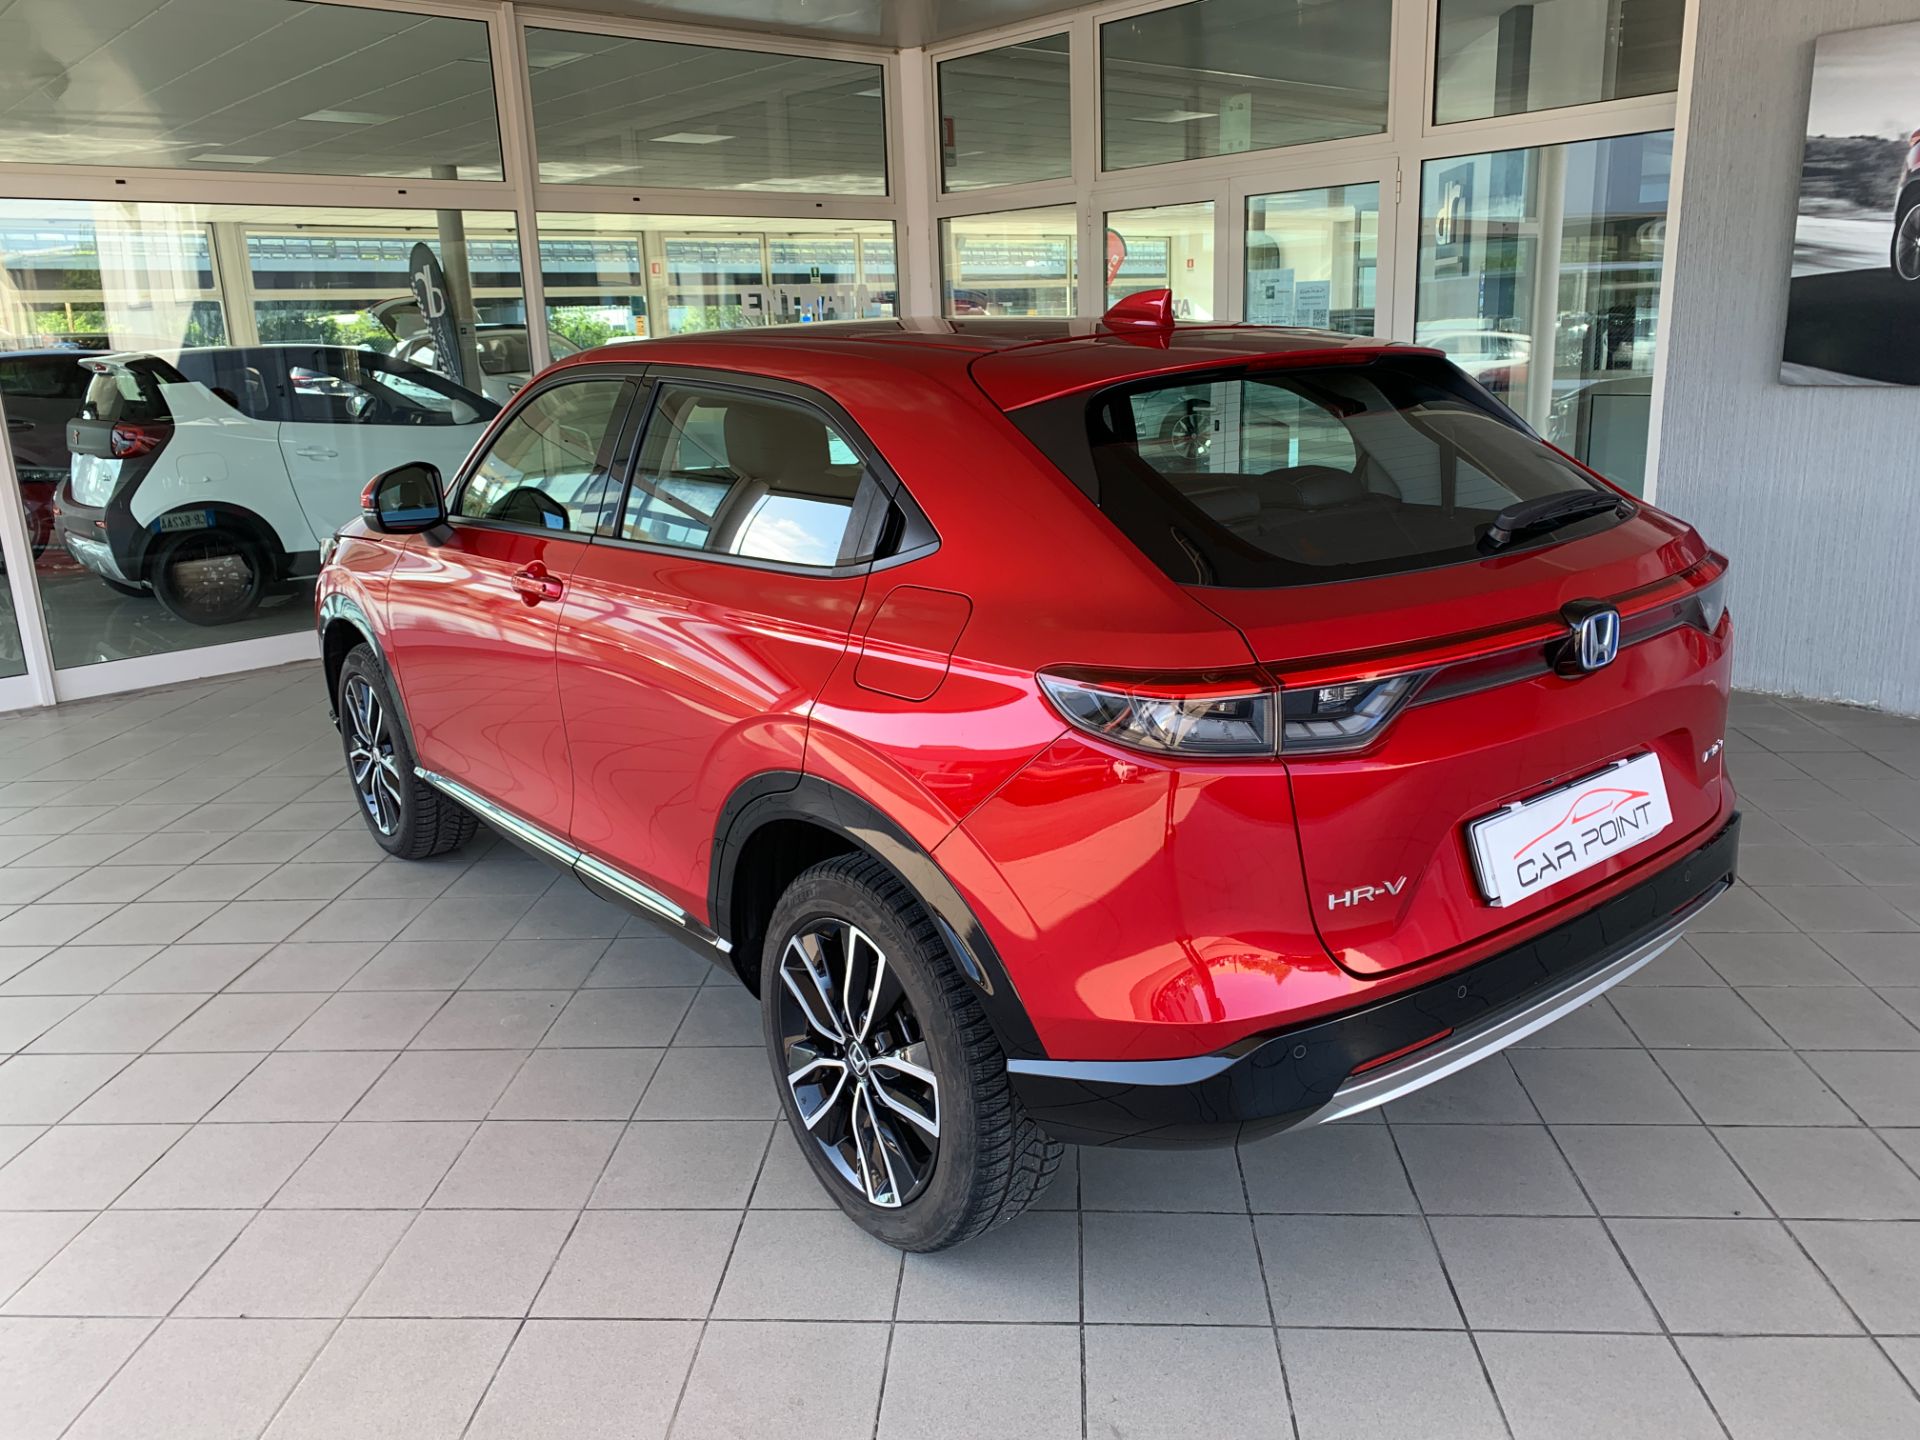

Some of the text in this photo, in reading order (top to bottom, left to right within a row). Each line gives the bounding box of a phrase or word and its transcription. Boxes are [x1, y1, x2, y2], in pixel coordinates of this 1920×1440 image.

[1516, 801, 1651, 888] CAR POINT
[1327, 875, 1407, 911] HR-V
